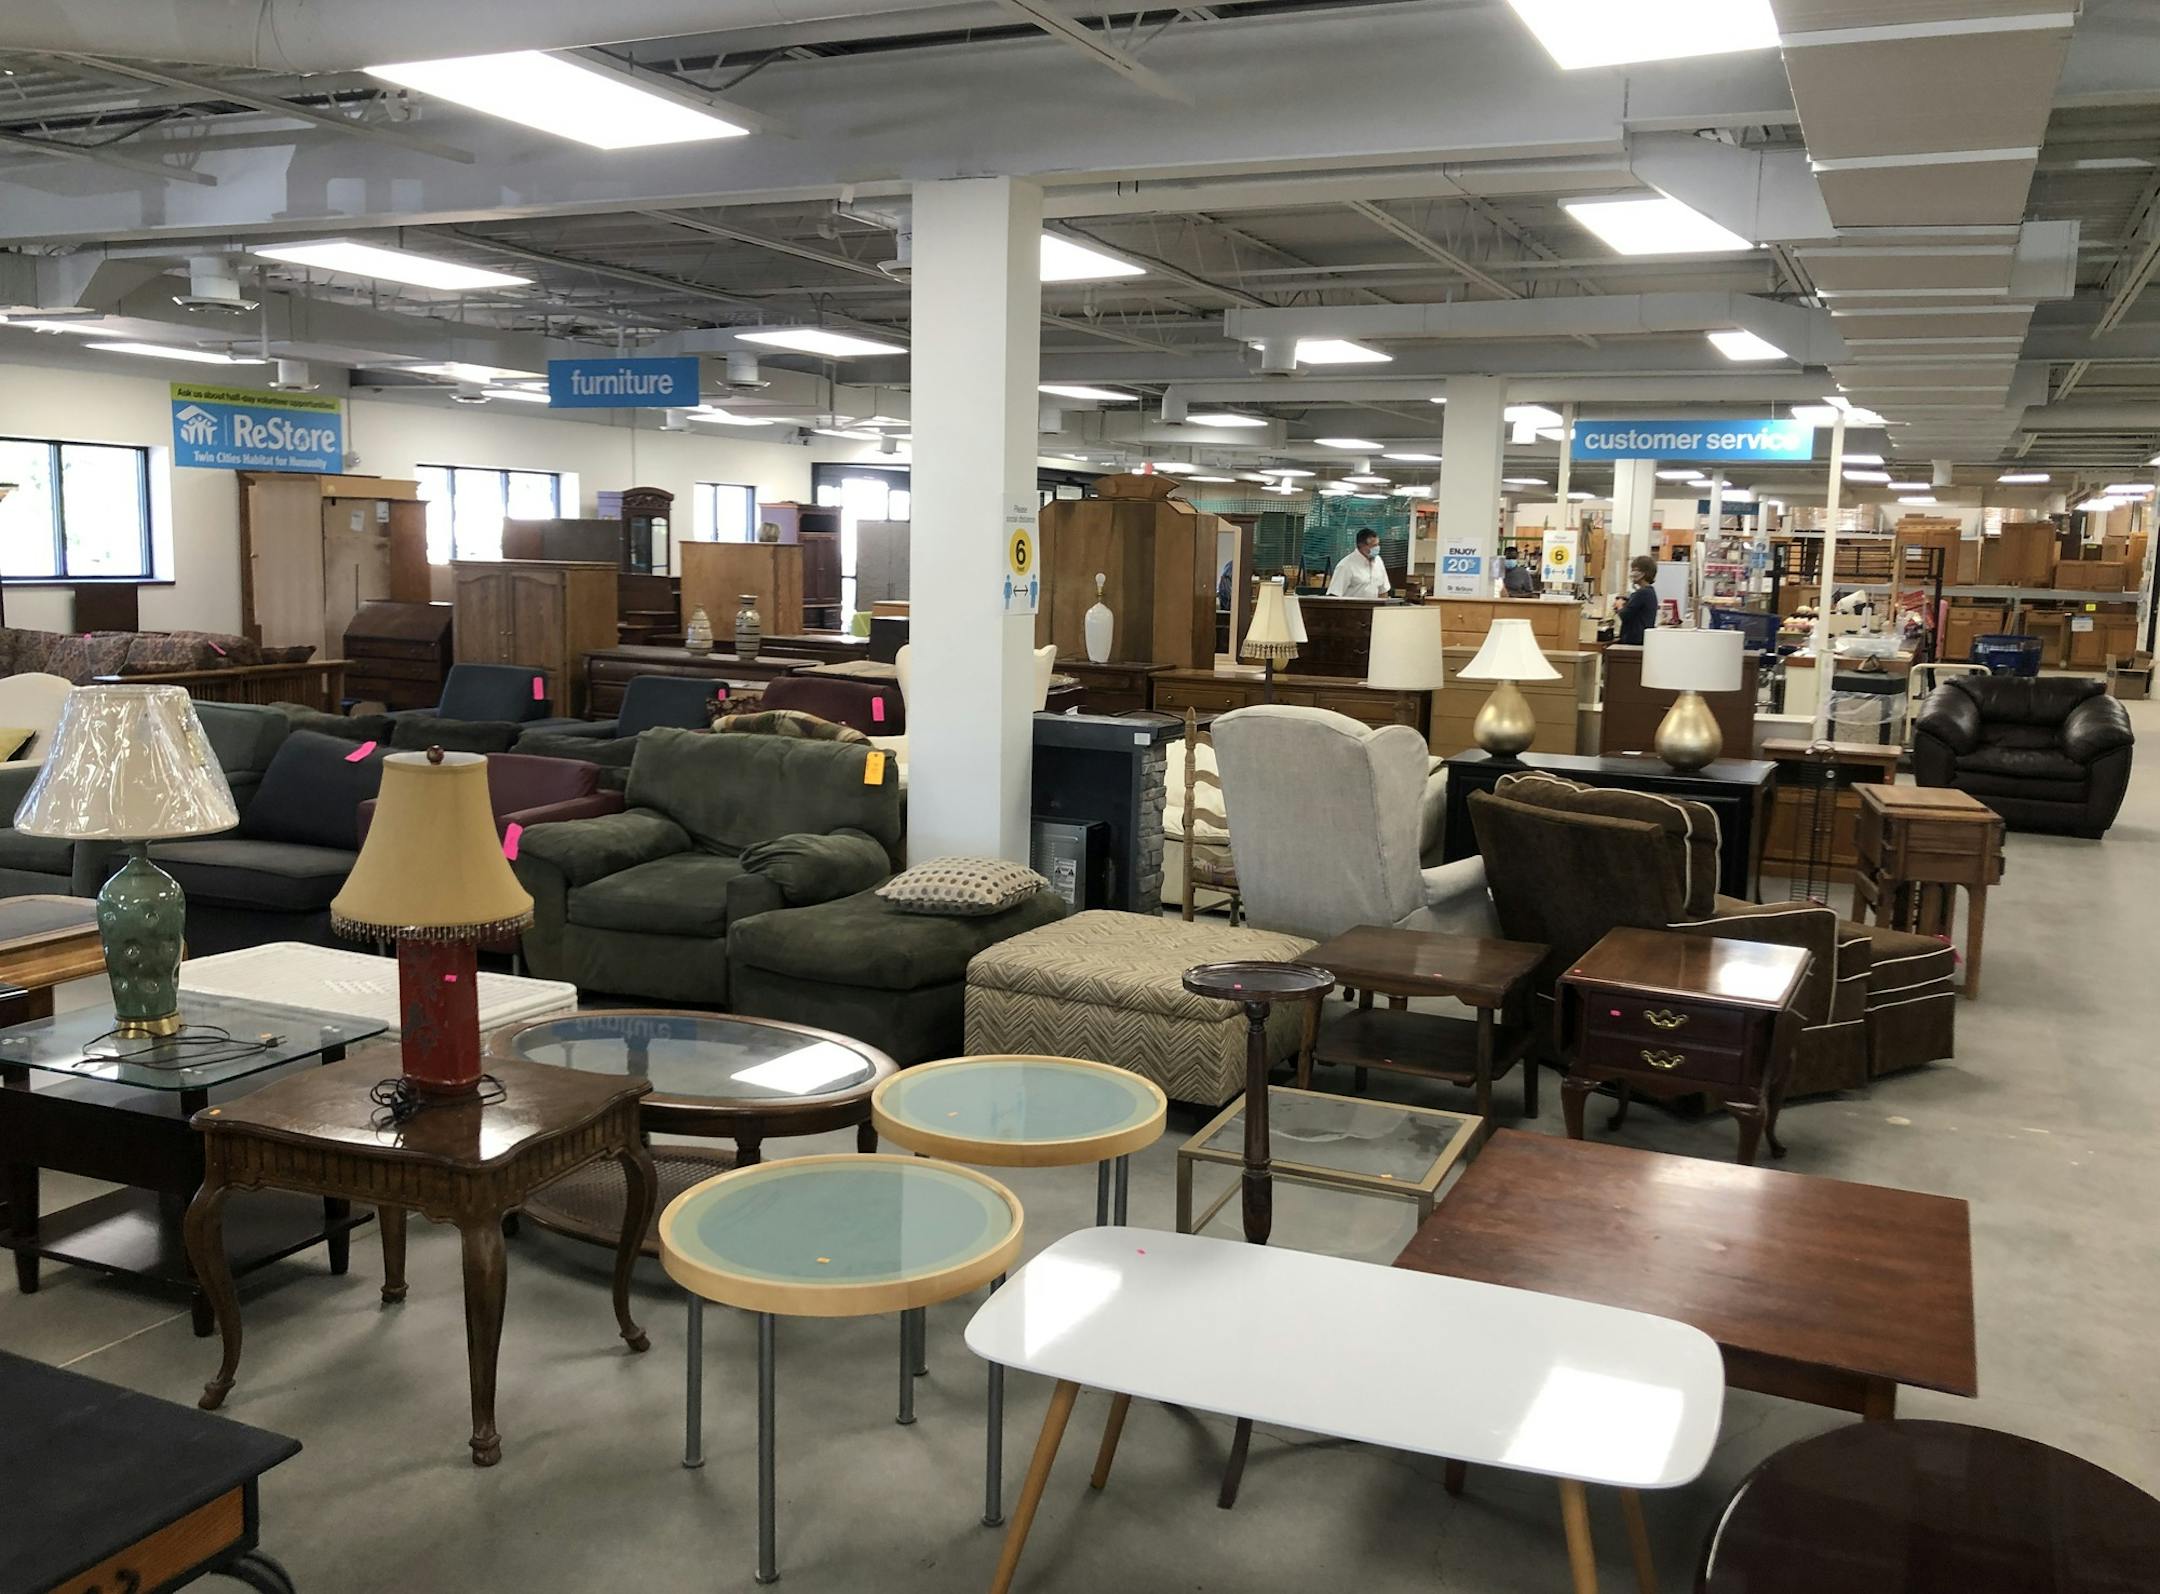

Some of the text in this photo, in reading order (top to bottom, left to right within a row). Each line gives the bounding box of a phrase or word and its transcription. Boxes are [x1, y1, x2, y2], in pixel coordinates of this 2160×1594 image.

[571, 368, 674, 395] furniture
[177, 388, 192, 397] Ask
[204, 391, 225, 400] about
[233, 414, 336, 453] ReStore
[1584, 427, 1800, 450] customer service
[193, 450, 215, 463] Twin
[216, 452, 242, 464] Cities
[243, 454, 273, 466] Habitat
[275, 456, 288, 466] for
[1016, 539, 1026, 566] 6
[1449, 548, 1477, 556] ENJOY
[1555, 550, 1564, 561] 6
